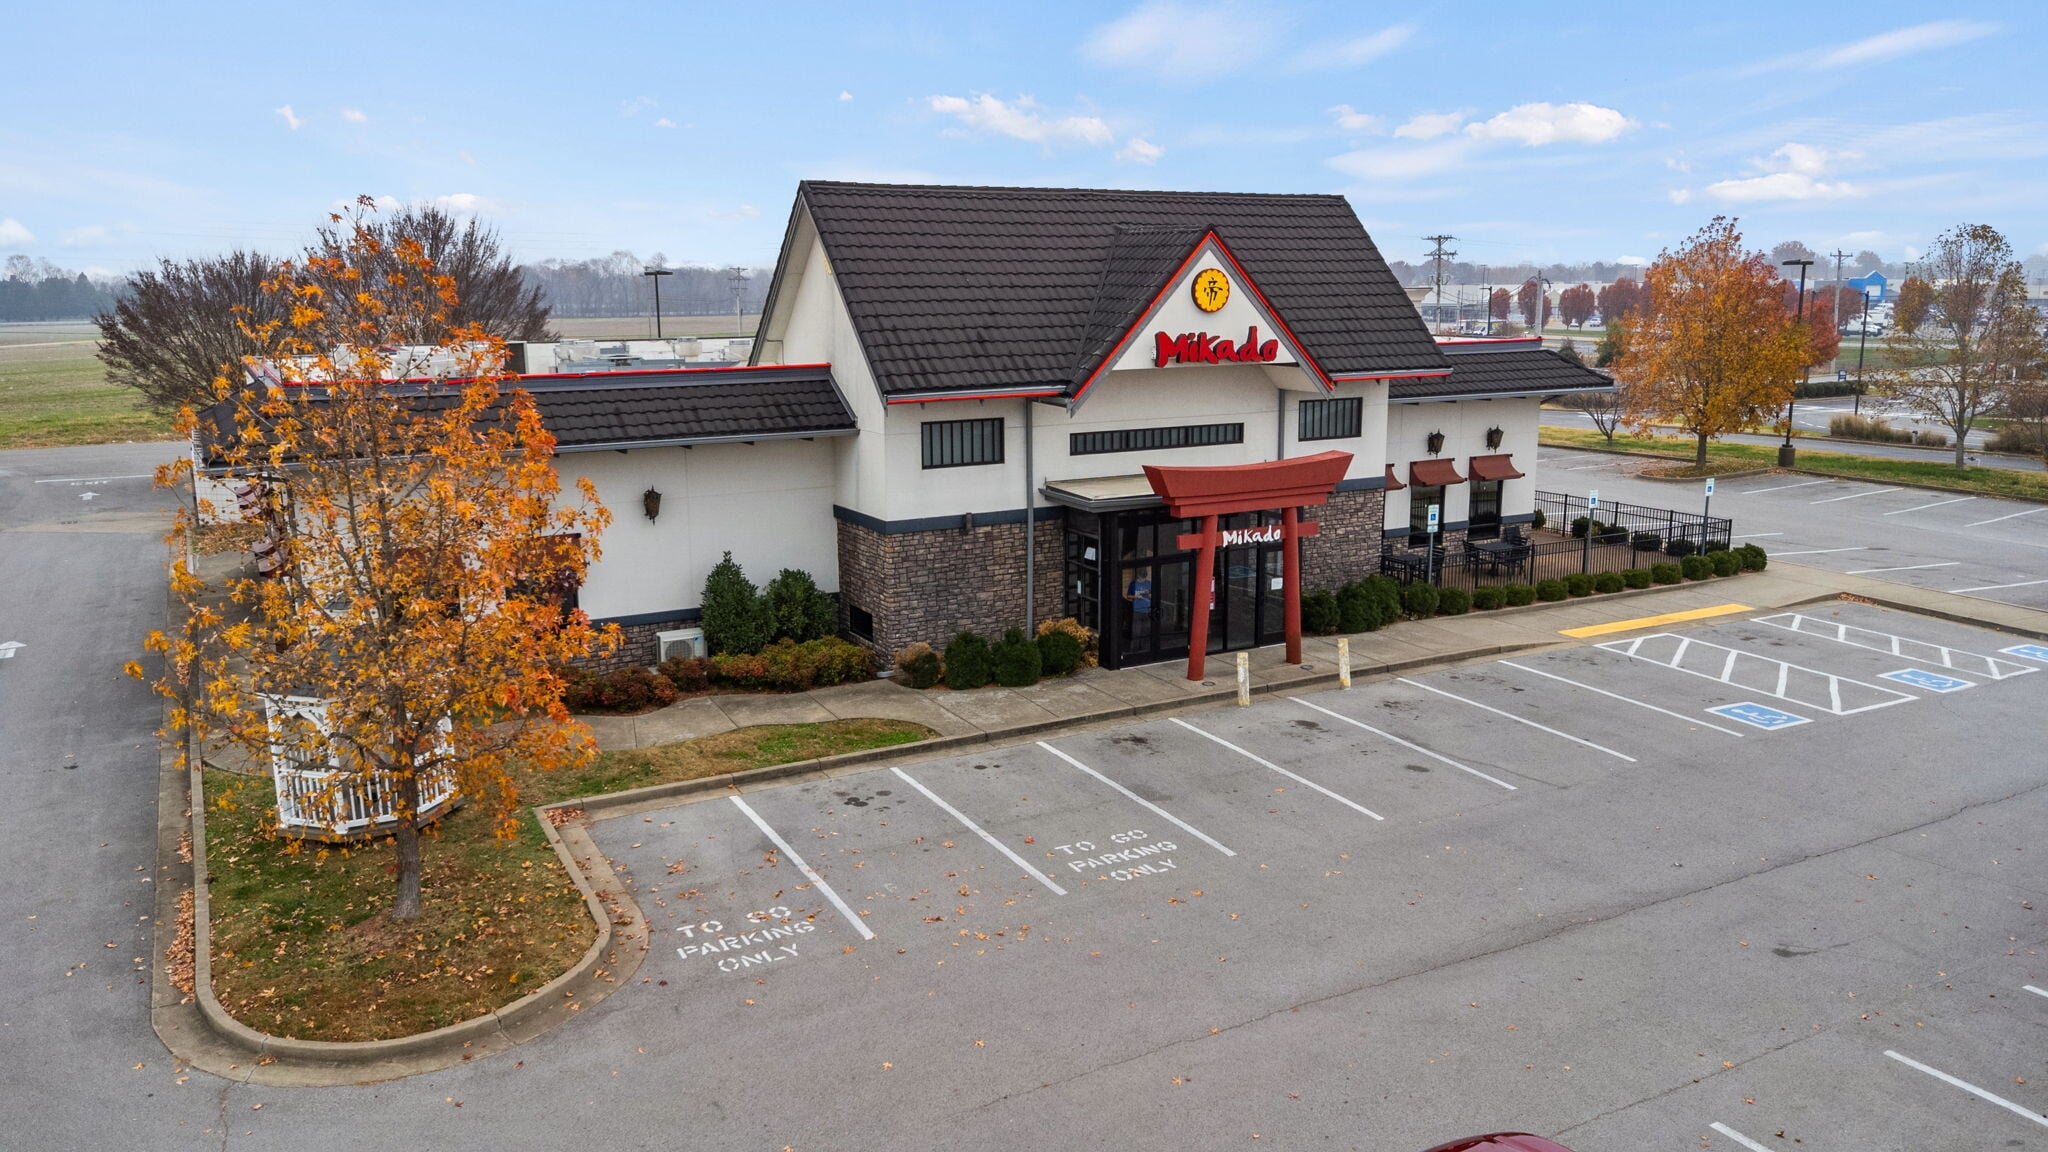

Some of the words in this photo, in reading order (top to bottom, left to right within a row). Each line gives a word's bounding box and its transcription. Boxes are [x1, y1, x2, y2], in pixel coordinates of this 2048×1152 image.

[1155, 326, 1278, 368] Mikado
[1222, 524, 1281, 548] Mikado
[1054, 841, 1096, 855] TO
[1110, 829, 1148, 844] GO
[1067, 841, 1177, 873] PARKING
[1110, 858, 1177, 881] ONLY
[676, 920, 723, 938] TO
[676, 921, 815, 960] PARKING
[718, 943, 799, 972] ONLY
